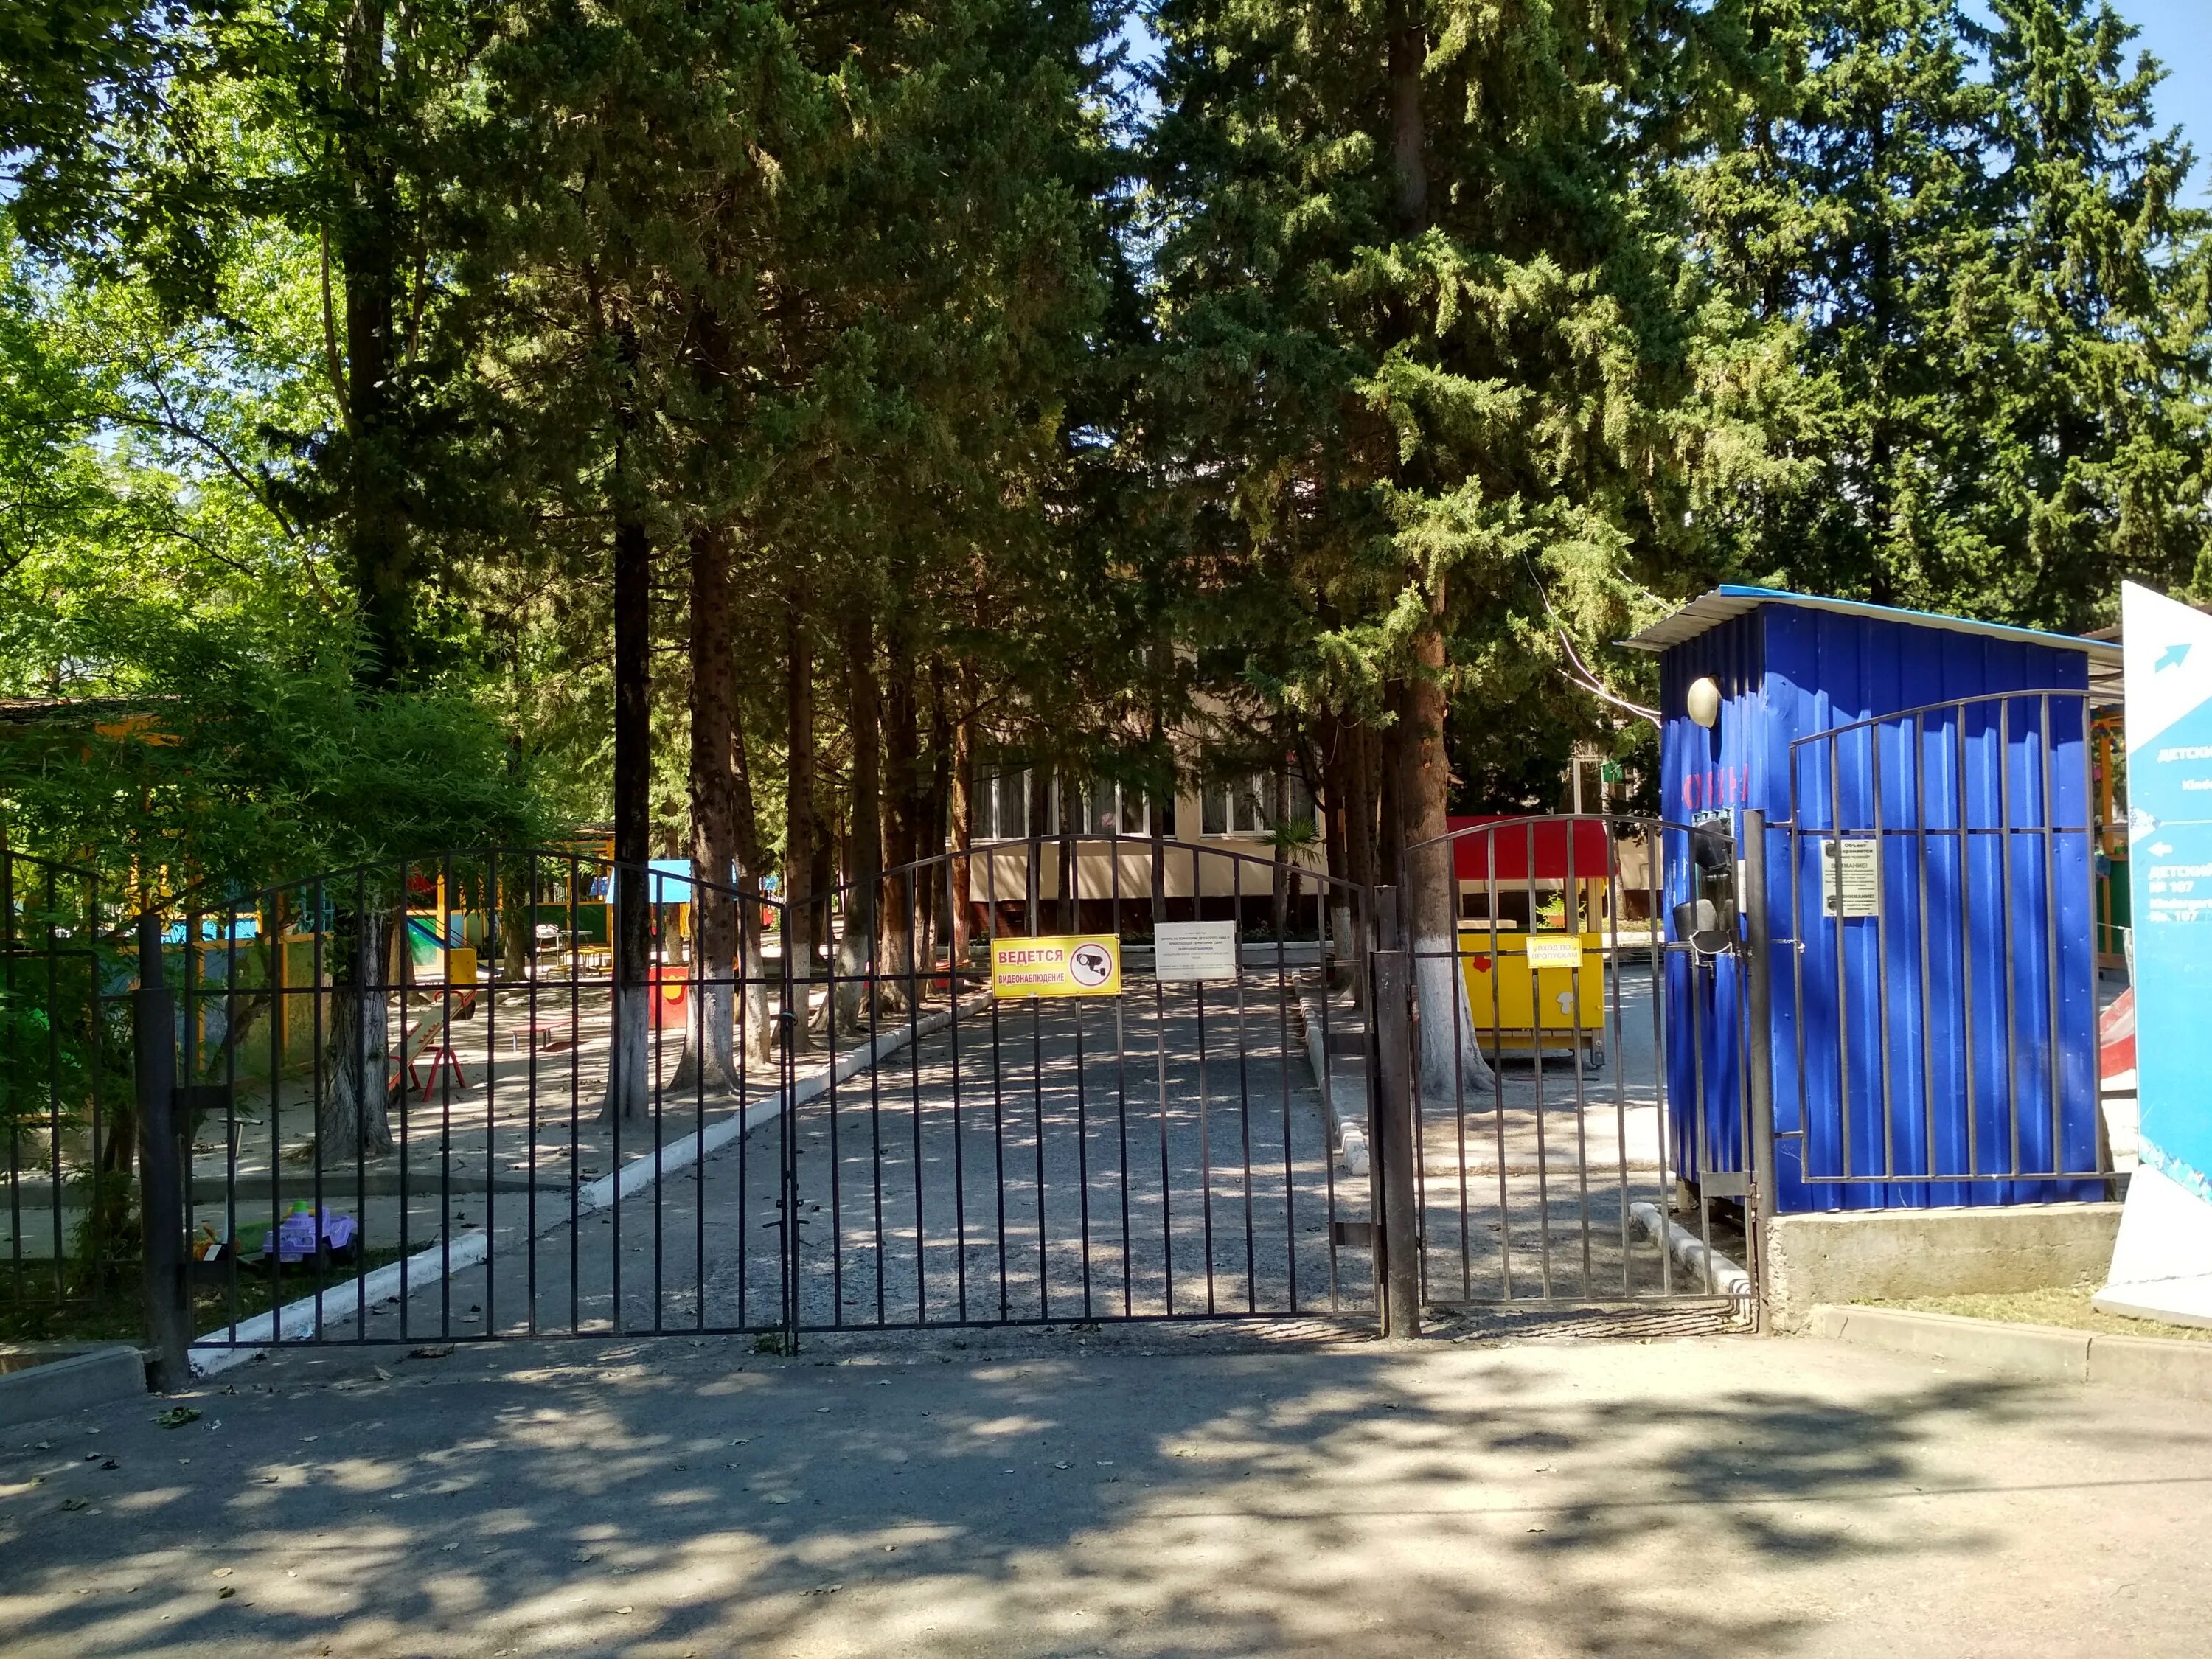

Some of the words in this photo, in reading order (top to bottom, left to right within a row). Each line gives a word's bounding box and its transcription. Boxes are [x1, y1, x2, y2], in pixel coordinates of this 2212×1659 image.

[2170, 880, 2194, 893] 107
[2174, 910, 2199, 922] 107
[998, 949, 1063, 965] ВЕДЕТСЯ
[998, 973, 1065, 985] ВИДЕОНАБЛЮДЕНИЕ
